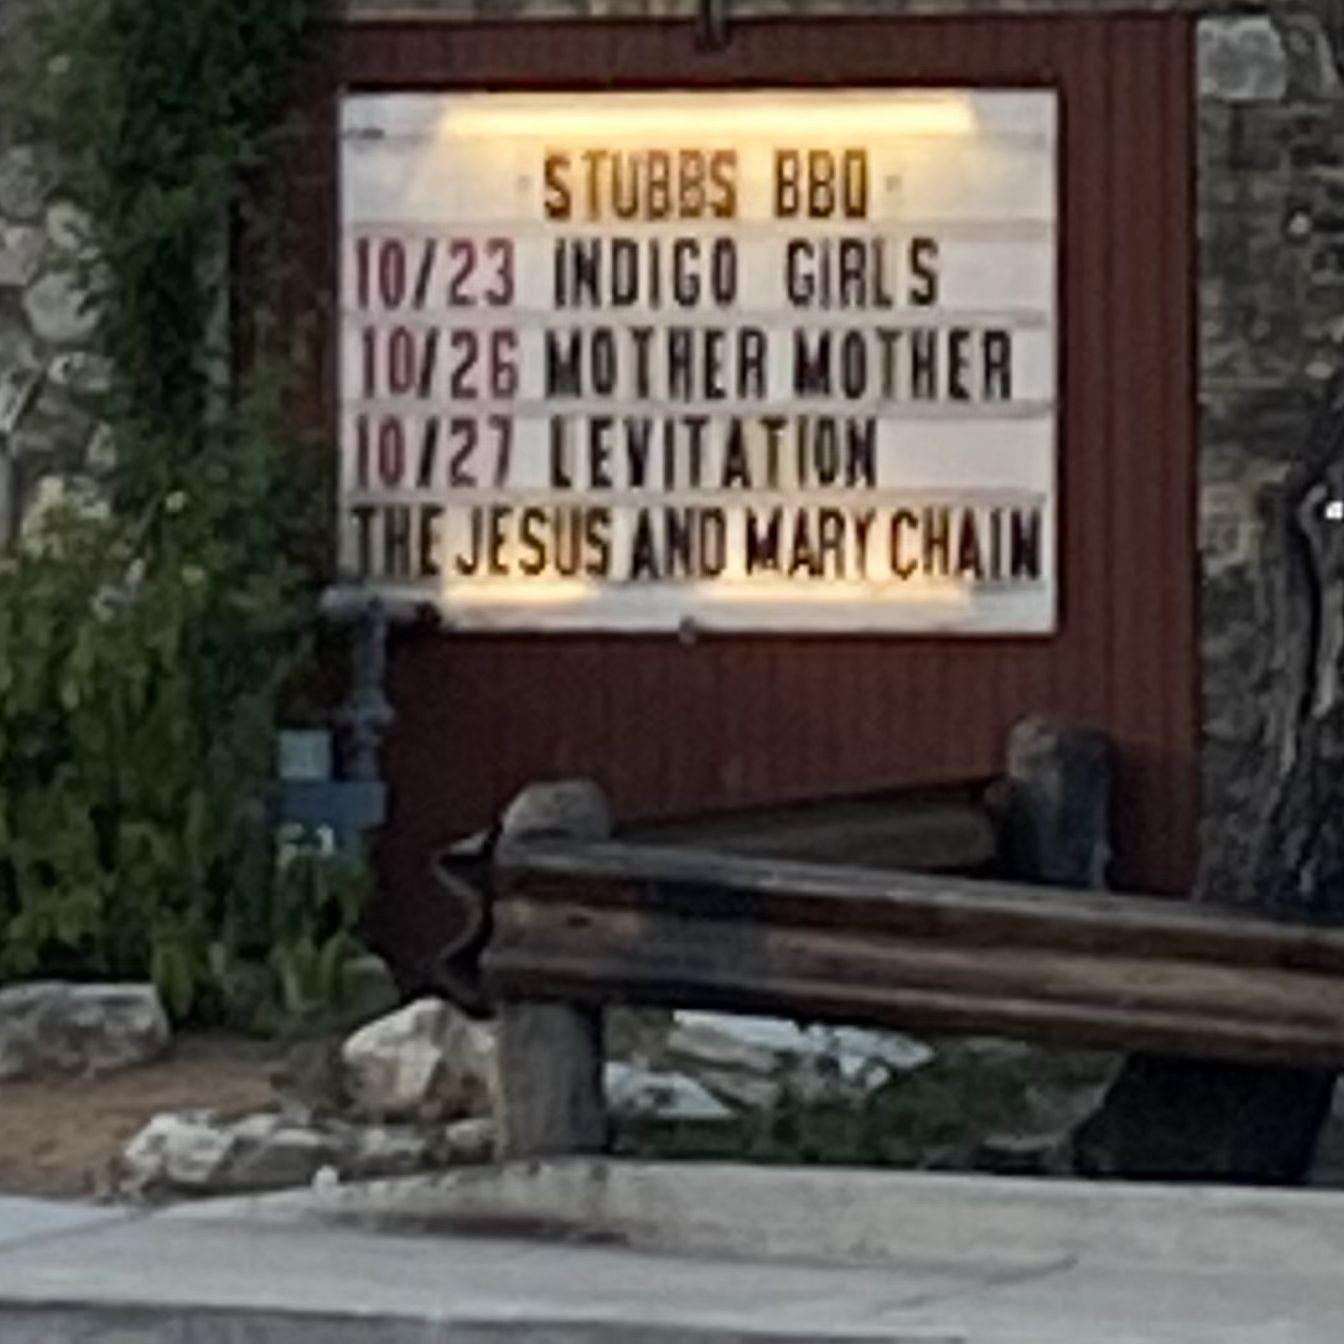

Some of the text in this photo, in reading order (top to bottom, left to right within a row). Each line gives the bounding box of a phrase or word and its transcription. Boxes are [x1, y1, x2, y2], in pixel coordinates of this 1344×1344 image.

[543, 148, 739, 220] STUBBS
[356, 238, 940, 308] 10/23 INDIGO GIRLS
[361, 326, 1014, 401] 10/26 MOTHER MOTHER
[356, 416, 877, 488] 10/27 LEVITATION
[353, 507, 1042, 578] THE JESUS AND MARY CHAIN
